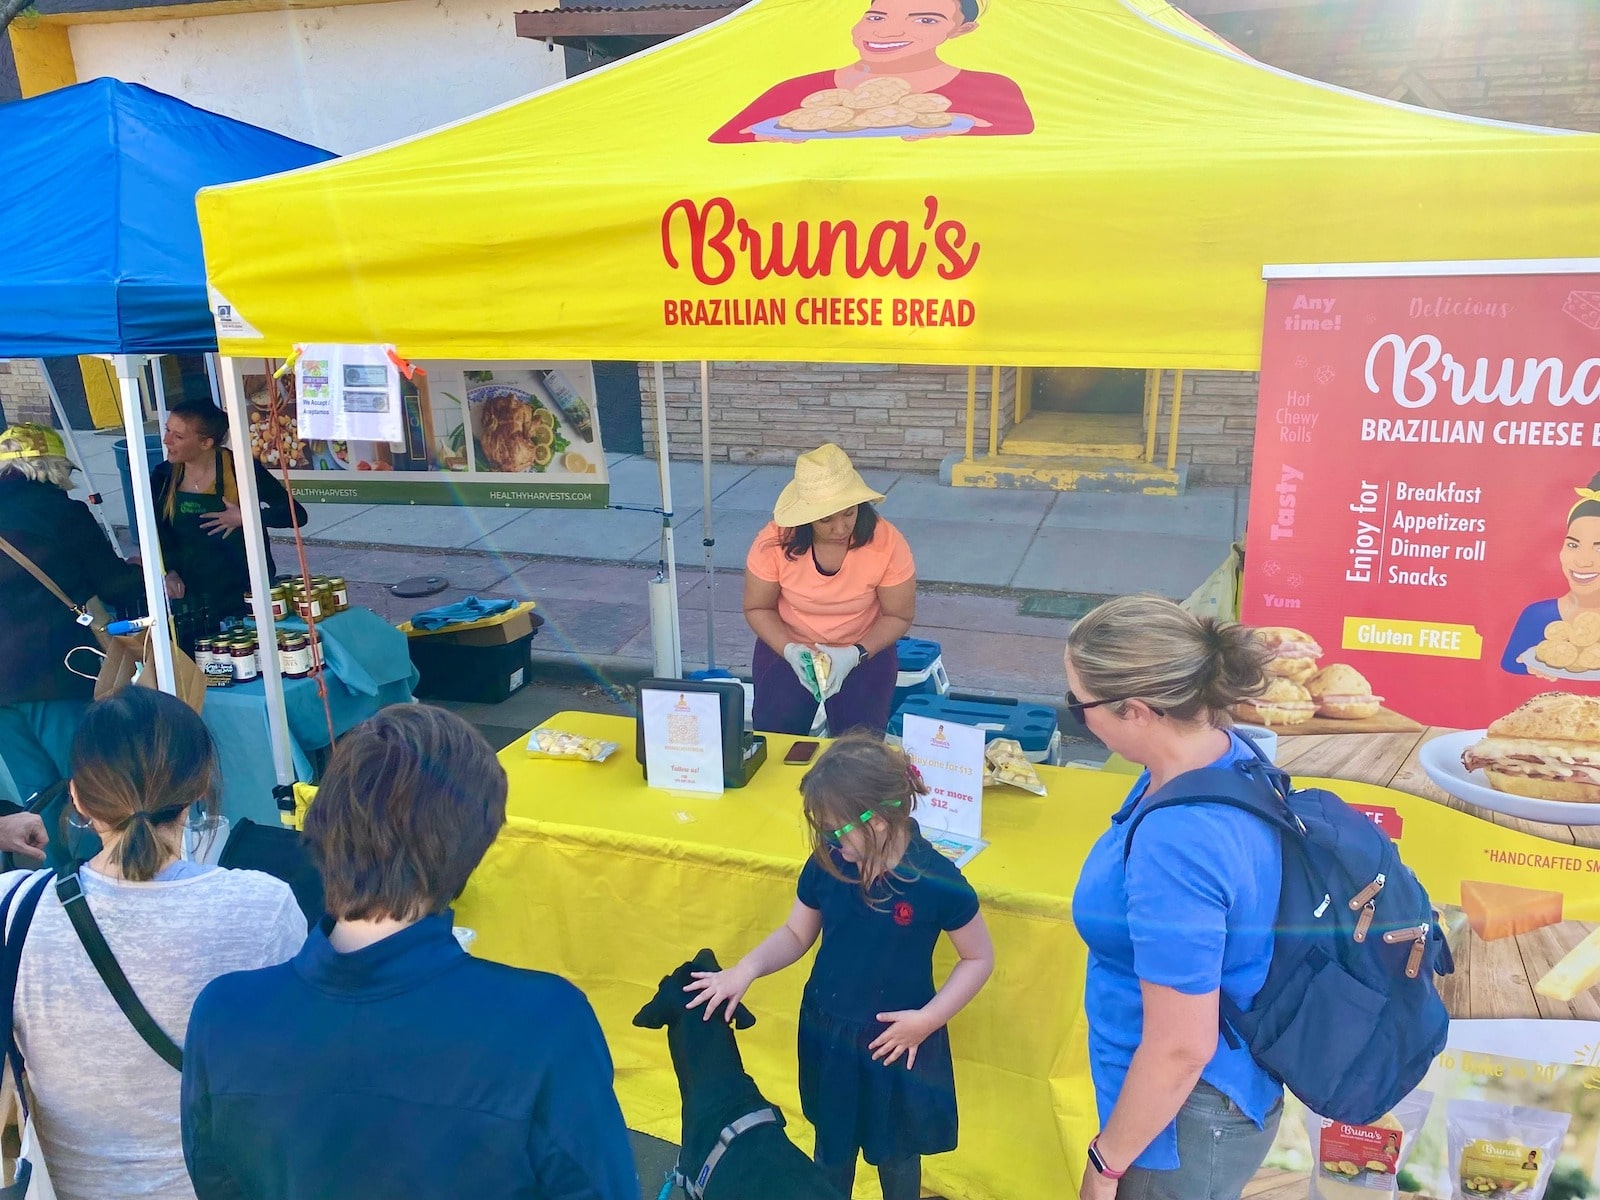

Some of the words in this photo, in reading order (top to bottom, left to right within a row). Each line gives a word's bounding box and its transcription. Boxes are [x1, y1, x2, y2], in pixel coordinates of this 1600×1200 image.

[661, 195, 981, 286] Bruna's
[664, 299, 786, 326] BRAZILIAN
[795, 297, 882, 326] CHEESE
[892, 298, 976, 327] BREAD
[1292, 294, 1337, 313] Any
[1409, 296, 1518, 319] Delicious
[1284, 314, 1342, 332] time!
[1286, 390, 1311, 408] Hot
[1276, 407, 1319, 429] Chewy
[1279, 426, 1312, 443] Rolls
[1361, 418, 1485, 444] BRAZILIAN
[1492, 420, 1584, 446] CHEESE
[291, 488, 358, 497] EALTHYHARVESTS
[490, 491, 592, 501] HEALTHYHARVESTS.COM
[1270, 464, 1304, 541] Tasty
[1349, 480, 1379, 514] for
[1395, 481, 1483, 504] Breakfast
[1391, 509, 1486, 535] Appetizers
[1345, 520, 1381, 583] Enjoy
[1390, 537, 1450, 560] Dinner
[1454, 540, 1486, 562] roll
[1387, 565, 1448, 588] Snacks
[1263, 592, 1302, 609] Yum
[1357, 624, 1413, 648] Gluten
[1418, 628, 1461, 651] FREE
[929, 760, 944, 769] one
[946, 761, 959, 771] for
[960, 764, 973, 776] $13
[931, 797, 948, 810] $12
[934, 786, 946, 796] or
[947, 789, 973, 802] more
[1340, 1124, 1382, 1140] Bruna's
